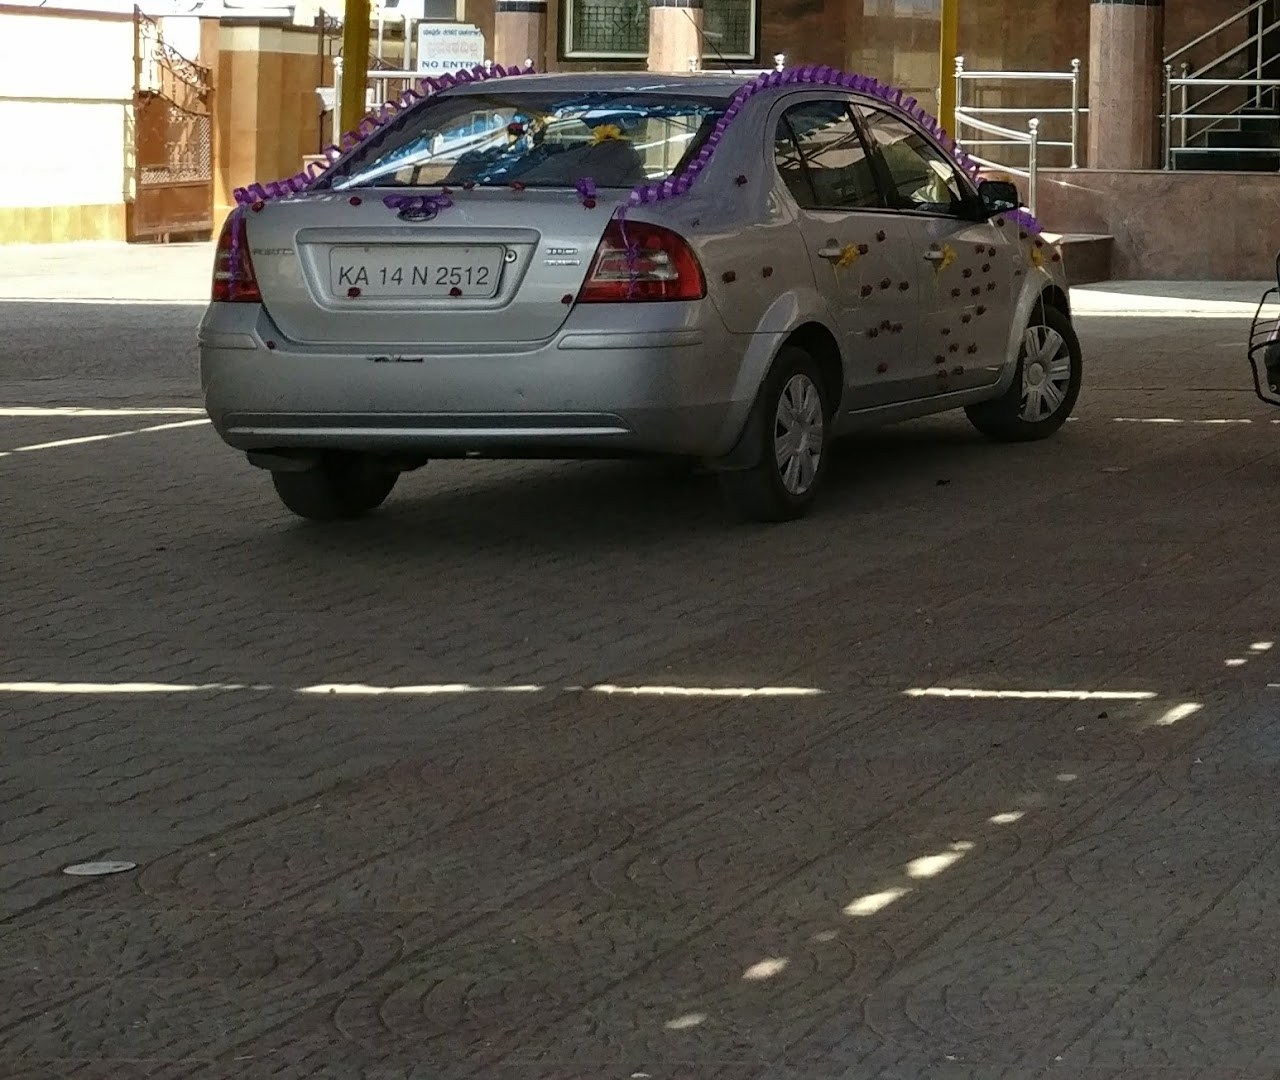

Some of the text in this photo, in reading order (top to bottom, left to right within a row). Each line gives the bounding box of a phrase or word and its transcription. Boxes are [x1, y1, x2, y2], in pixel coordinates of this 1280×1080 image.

[421, 61, 439, 69] NO
[338, 266, 489, 285] KA 14 N 2512
